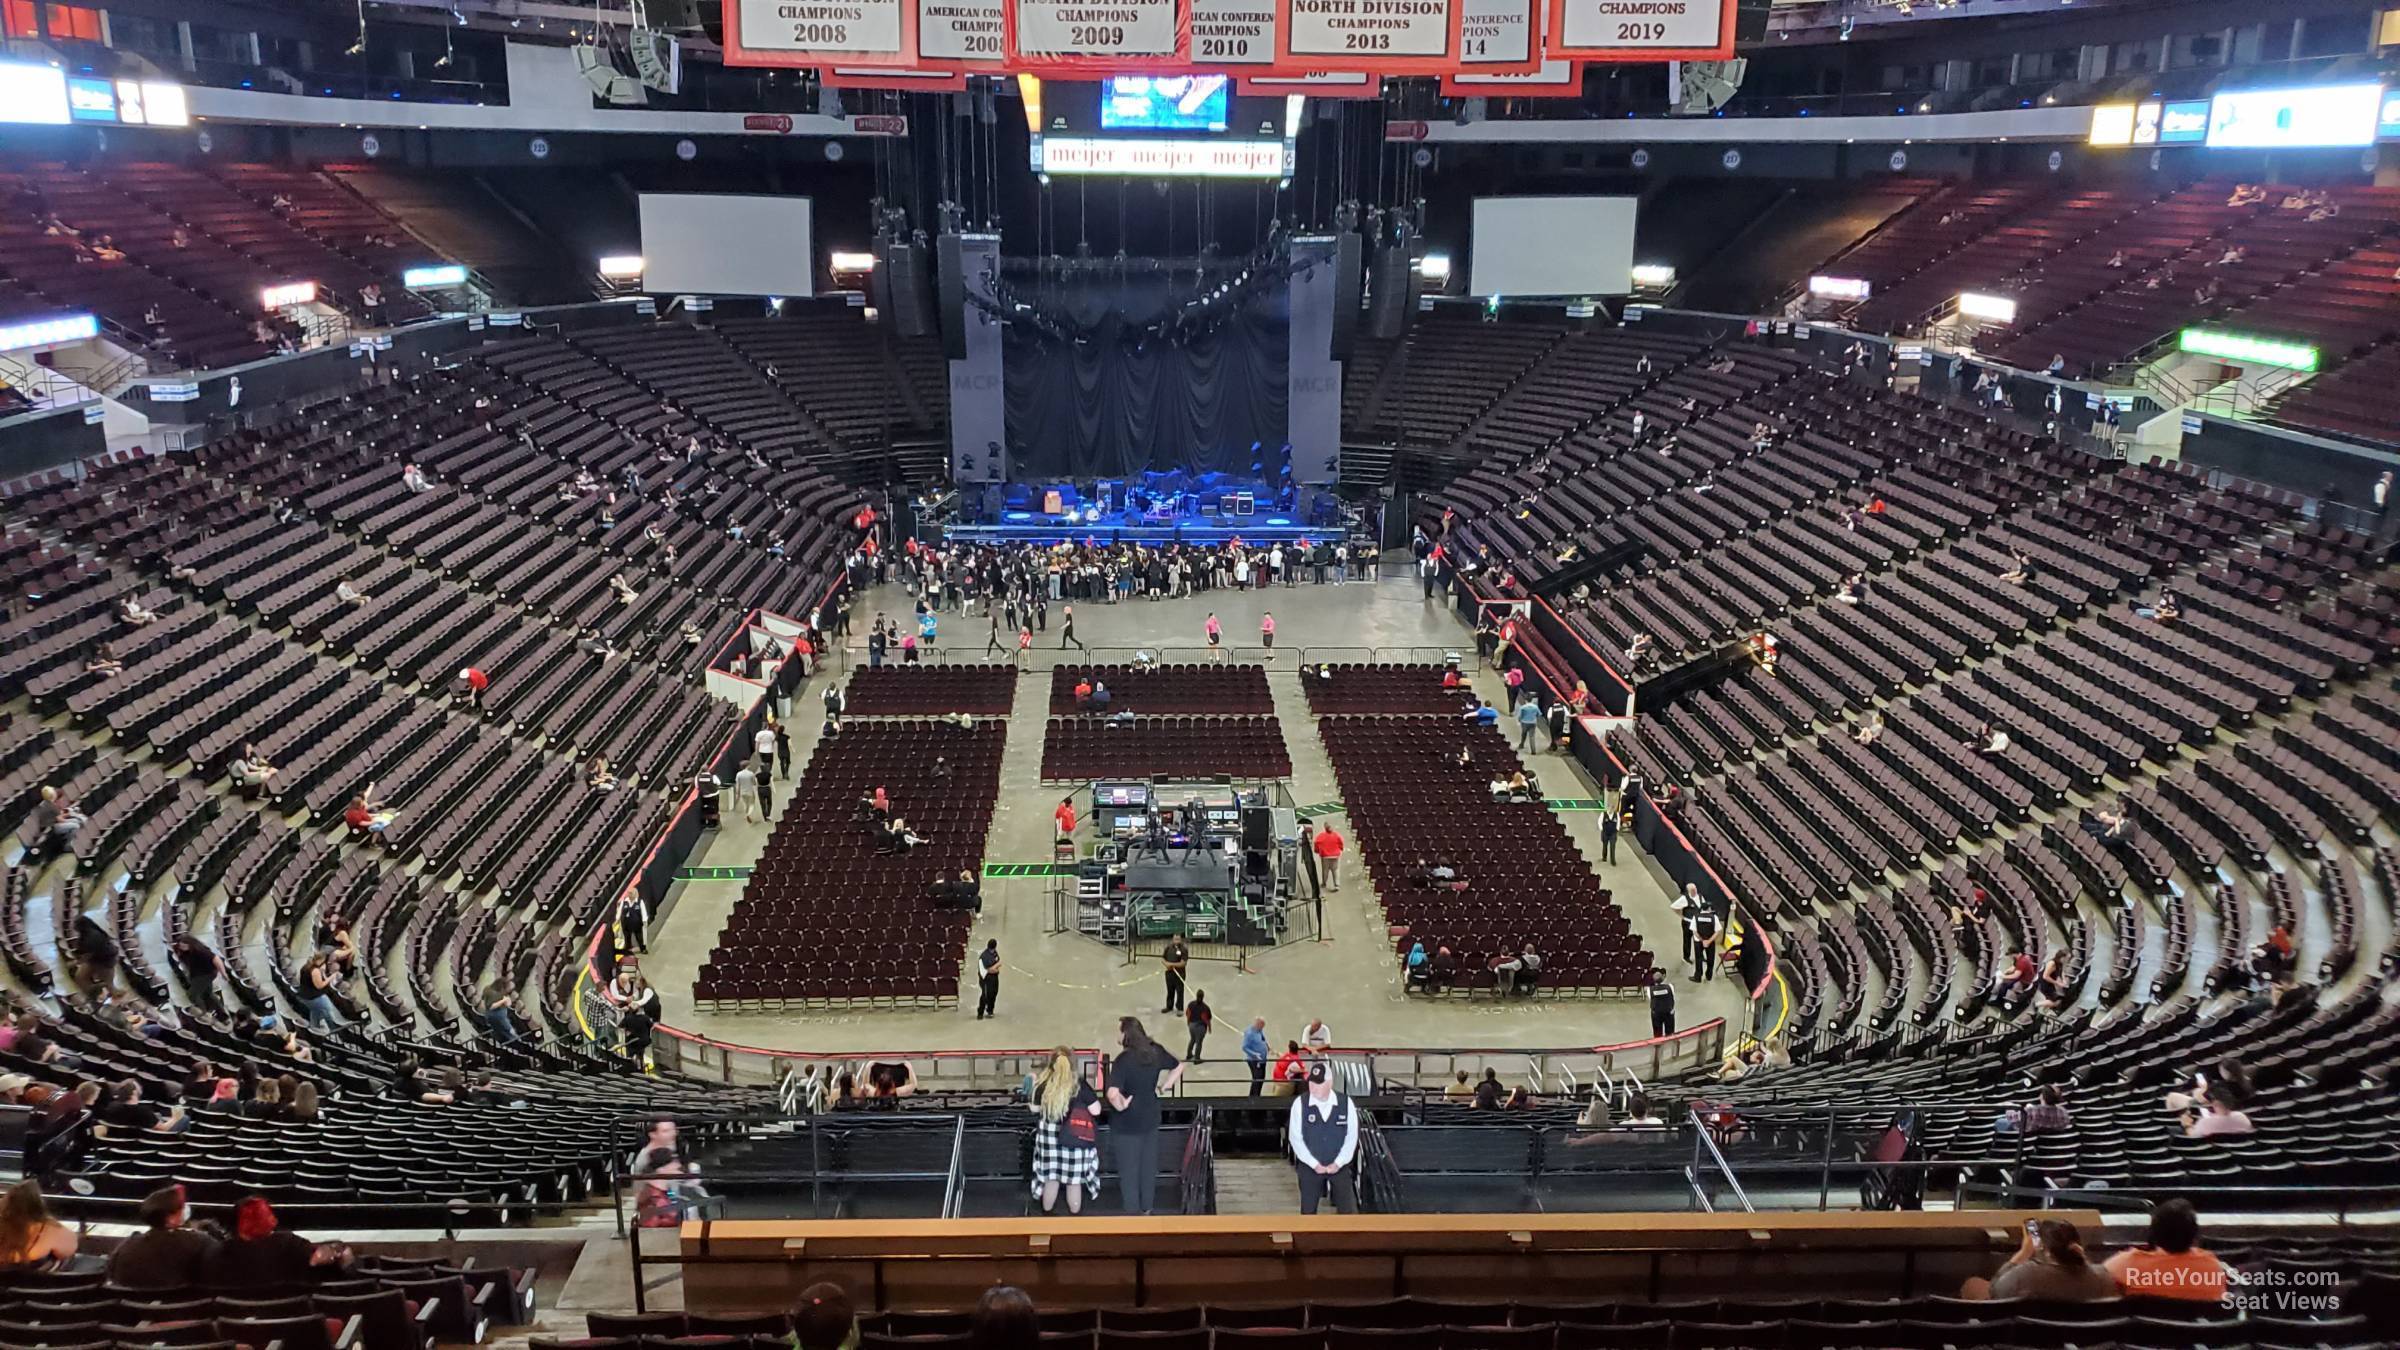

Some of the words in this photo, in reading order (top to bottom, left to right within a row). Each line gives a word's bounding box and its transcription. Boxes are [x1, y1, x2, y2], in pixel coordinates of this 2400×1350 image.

[778, 5, 862, 20] CHAMPIONS
[926, 6, 980, 18] AMERICAN
[1295, 1, 1355, 13] NORTH
[1362, 1, 1444, 14] DIVISION
[1599, 3, 1686, 15] CHAMPIONS
[1055, 9, 1138, 22] CHAMPIONS
[1191, 25, 1261, 36] CHAMPIONS
[1327, 18, 1410, 29] CHAMPIONS
[793, 23, 847, 43] 2008
[1071, 26, 1124, 45] 2009
[1462, 26, 1500, 37] PIONS
[1617, 23, 1665, 40] 2019
[1202, 39, 1248, 56] 2010
[1345, 34, 1390, 49] 2013
[1465, 39, 1486, 55] 14
[1052, 139, 1115, 168] meijer
[1132, 141, 1194, 169] meijer
[1213, 142, 1276, 170] meijer
